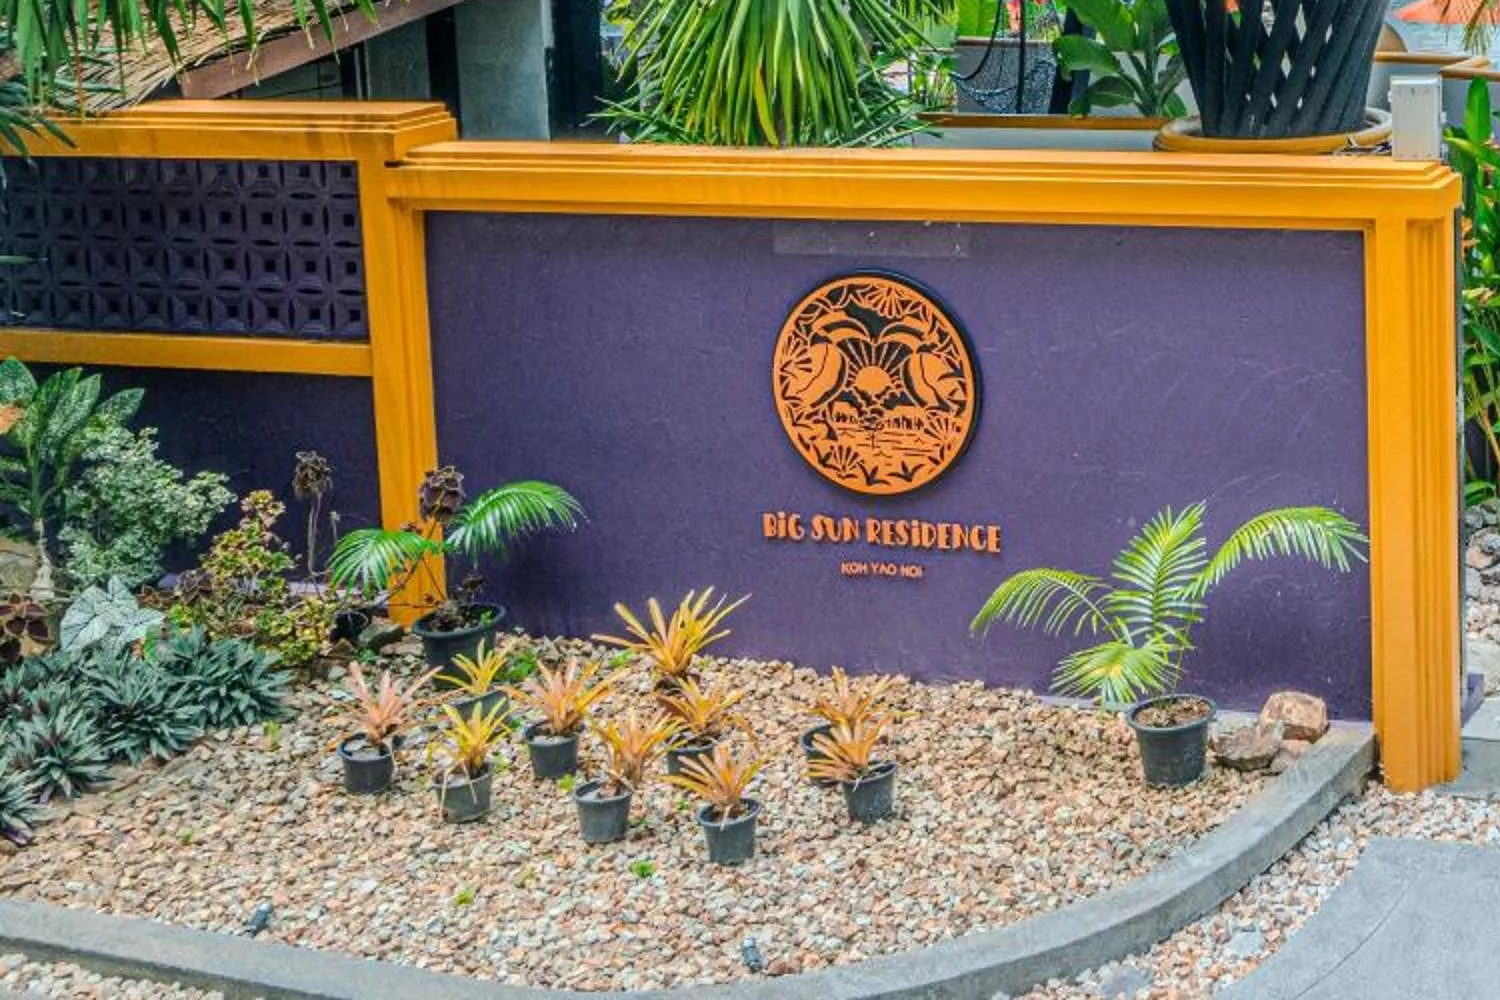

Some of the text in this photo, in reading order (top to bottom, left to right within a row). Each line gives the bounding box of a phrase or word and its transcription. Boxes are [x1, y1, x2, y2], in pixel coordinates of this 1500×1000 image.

[810, 514, 860, 543] SUN
[840, 561, 923, 578] KOH YAO NOI
